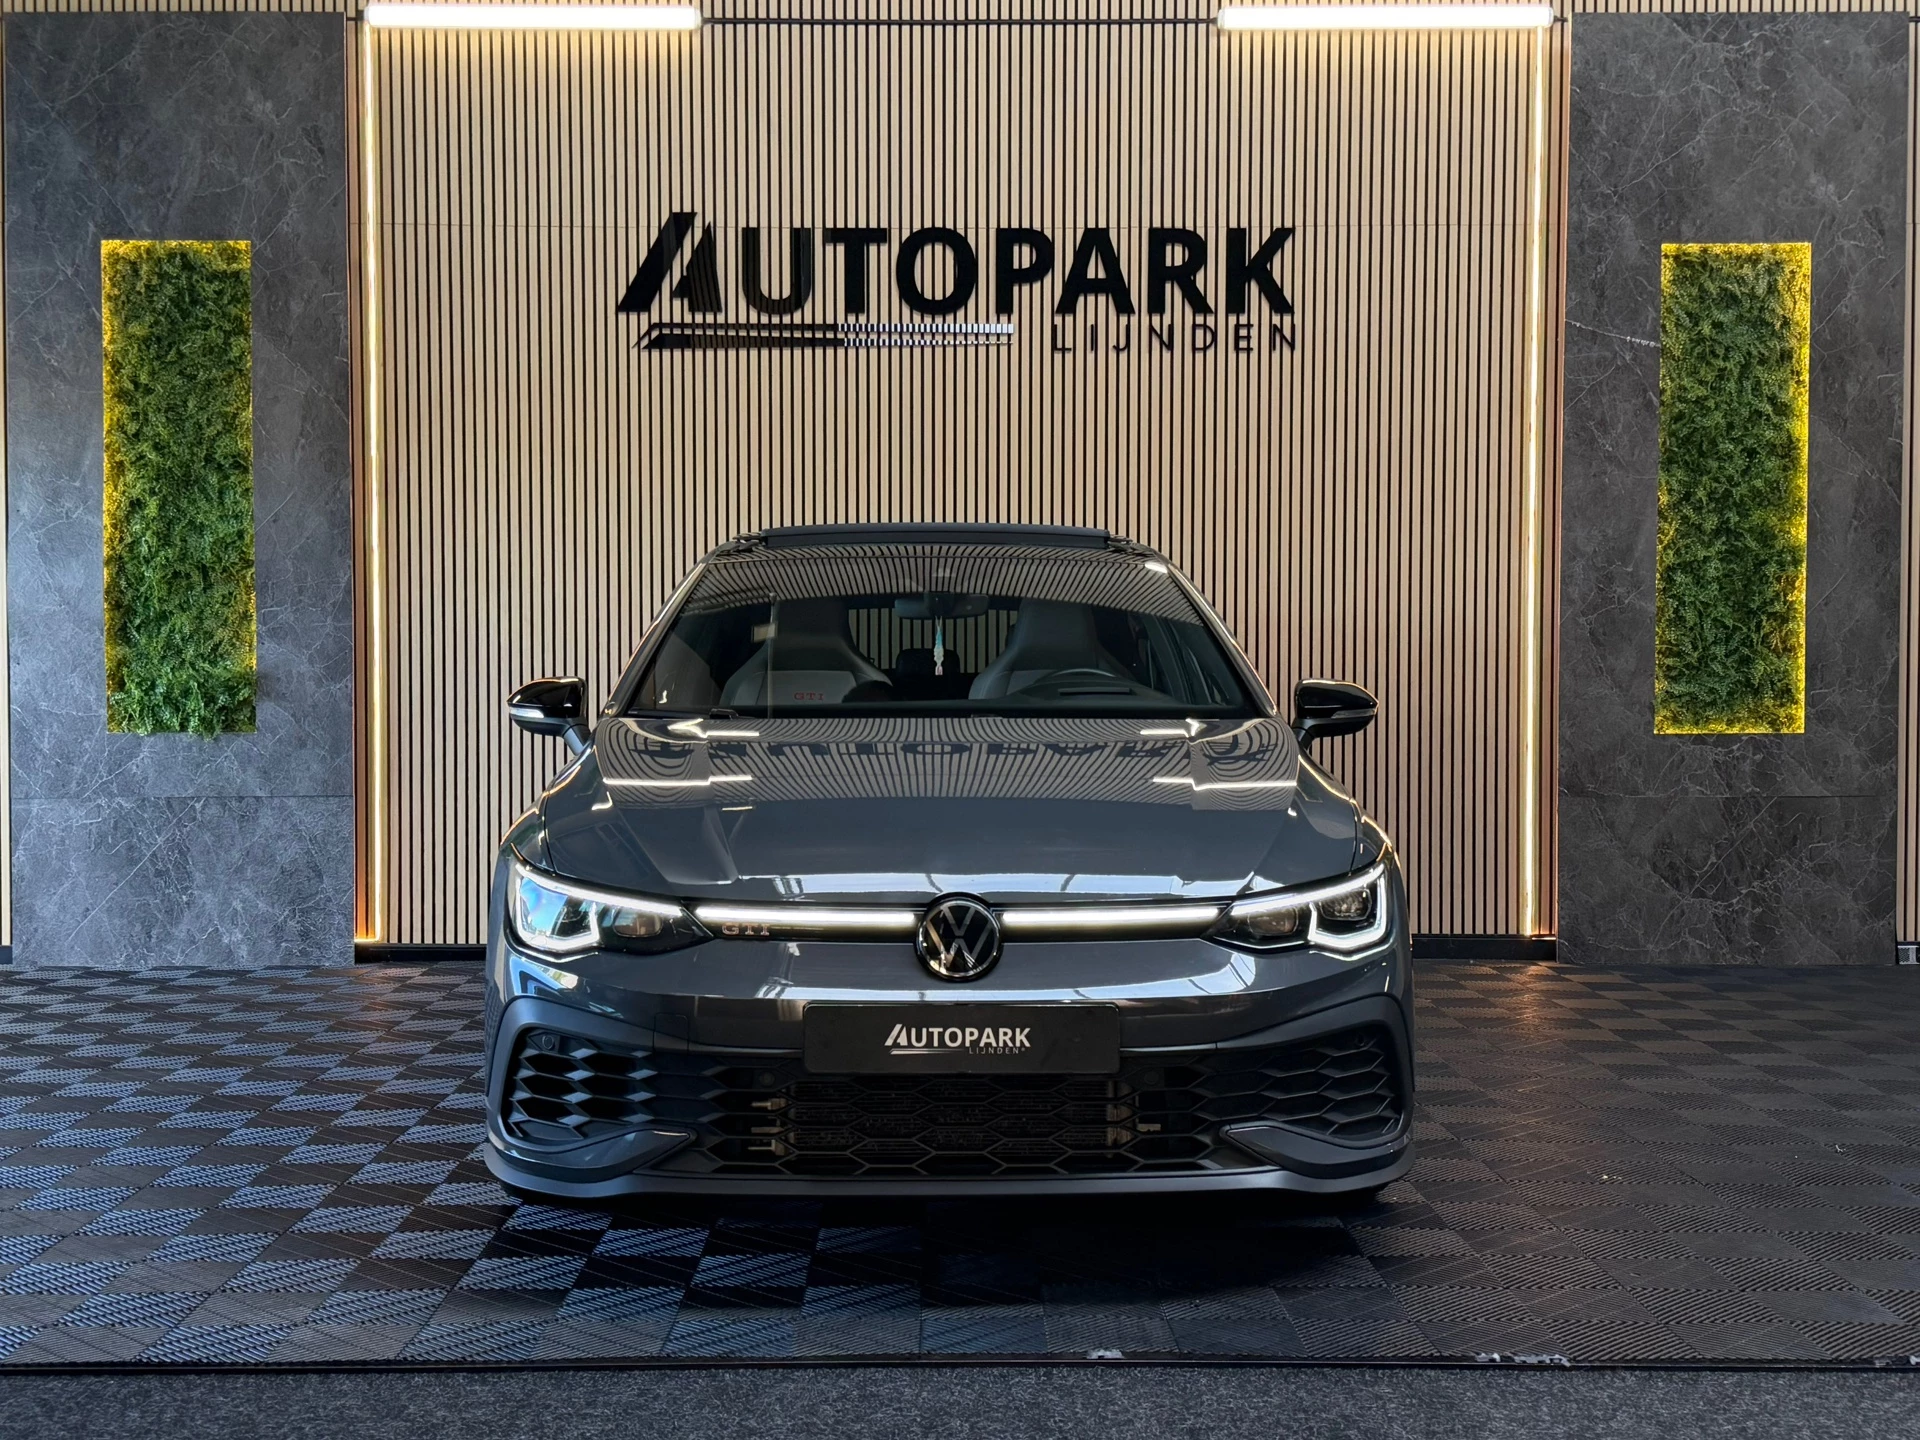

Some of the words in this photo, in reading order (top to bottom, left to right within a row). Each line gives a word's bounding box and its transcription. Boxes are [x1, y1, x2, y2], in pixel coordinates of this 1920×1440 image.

[617, 212, 1295, 315] AUTOPARK
[1053, 323, 1296, 352] LIJNDEN
[794, 692, 824, 701] GTI
[721, 922, 770, 936] GTI
[884, 1023, 1031, 1047] AUTOPARK
